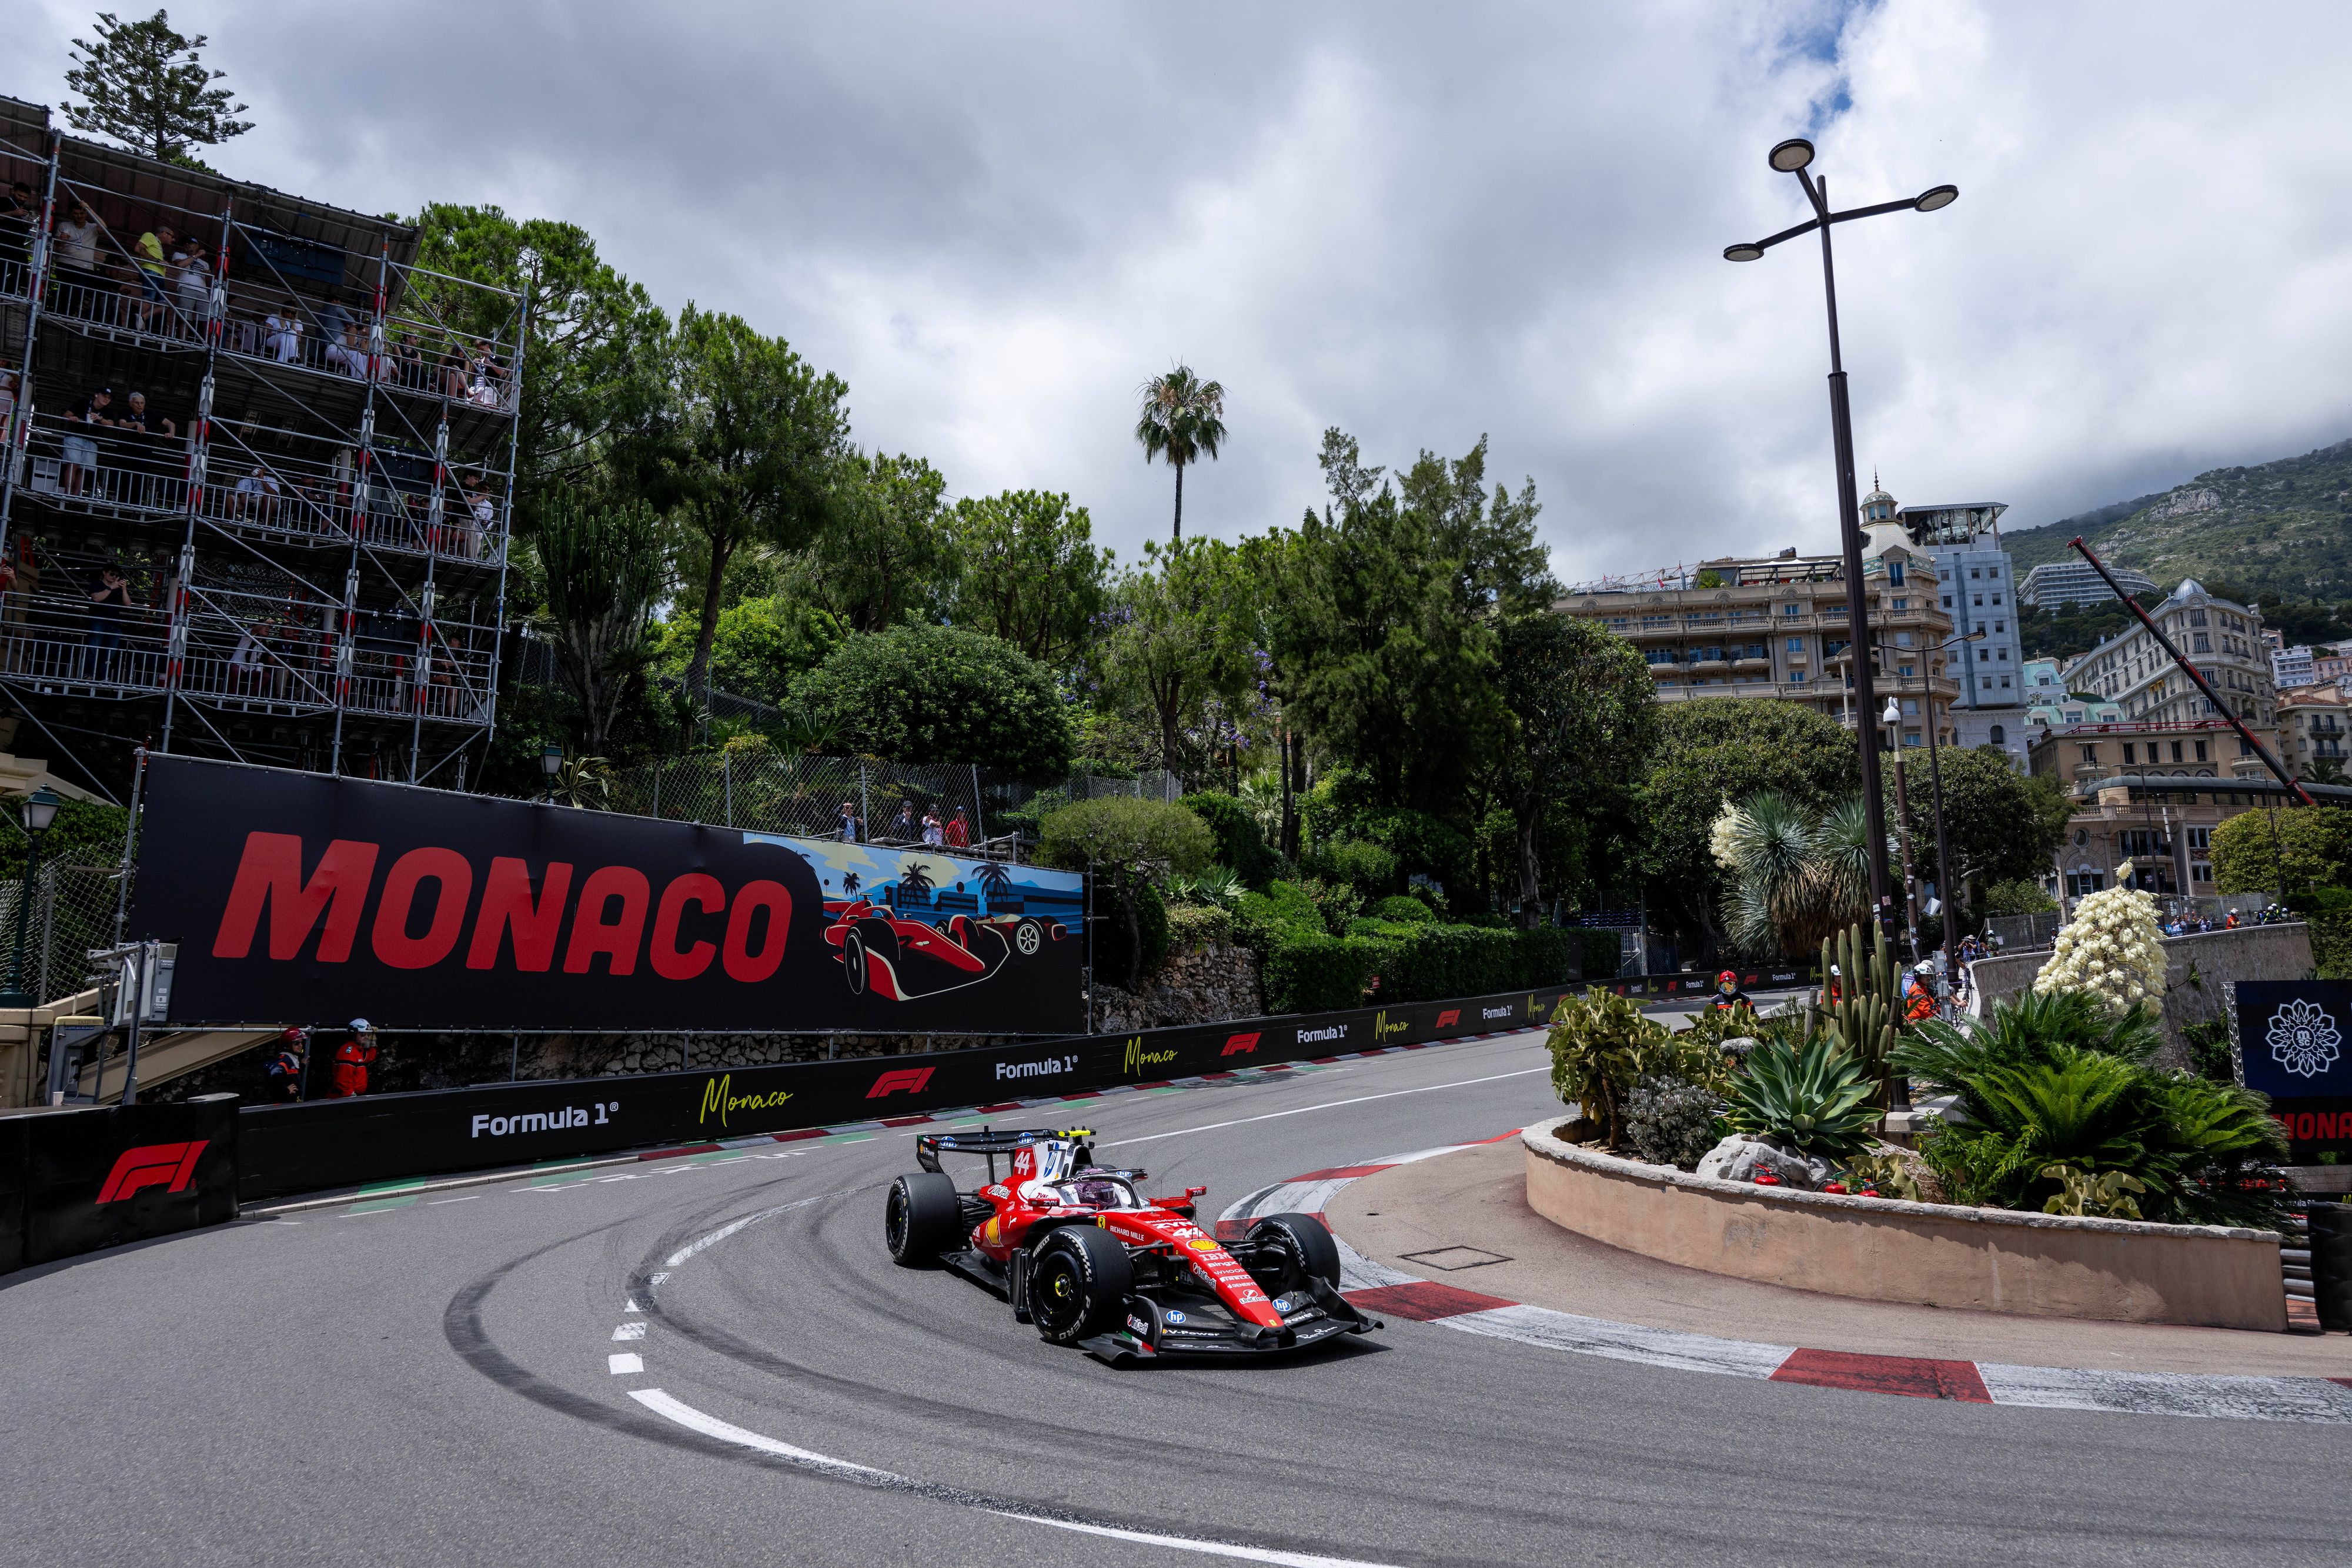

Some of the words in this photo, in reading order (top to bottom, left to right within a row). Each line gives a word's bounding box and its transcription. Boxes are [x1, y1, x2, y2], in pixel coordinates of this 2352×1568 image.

[213, 831, 792, 982] MONACO
[1772, 973, 1790, 981] Formula
[1686, 981, 1699, 989] Formula
[1482, 1006, 1506, 1019] Formula
[1375, 1009, 1409, 1042] Monaco
[1297, 1026, 1338, 1044] Formula
[1124, 1035, 1178, 1076] Monaco
[996, 1058, 1061, 1080] Formula
[700, 1074, 793, 1128] Monaco
[472, 1106, 588, 1138] Formula
[1014, 1151, 1031, 1176] 44
[1152, 1221, 1196, 1229] ZYN
[1172, 1227, 1204, 1238] 44
[1110, 1225, 1130, 1237] RICHARD
[1130, 1231, 1144, 1242] MILLE
[1199, 1252, 1234, 1262] IBM
[1180, 1269, 1192, 1283] FIA
[1197, 1265, 1217, 1291] UniCredit
[1085, 1295, 1091, 1309] P
[1275, 1299, 1288, 1312] hp
[1058, 1309, 1087, 1340] ZERO
[1170, 1311, 1183, 1323] hp
[1168, 1329, 1220, 1337] V-Power
